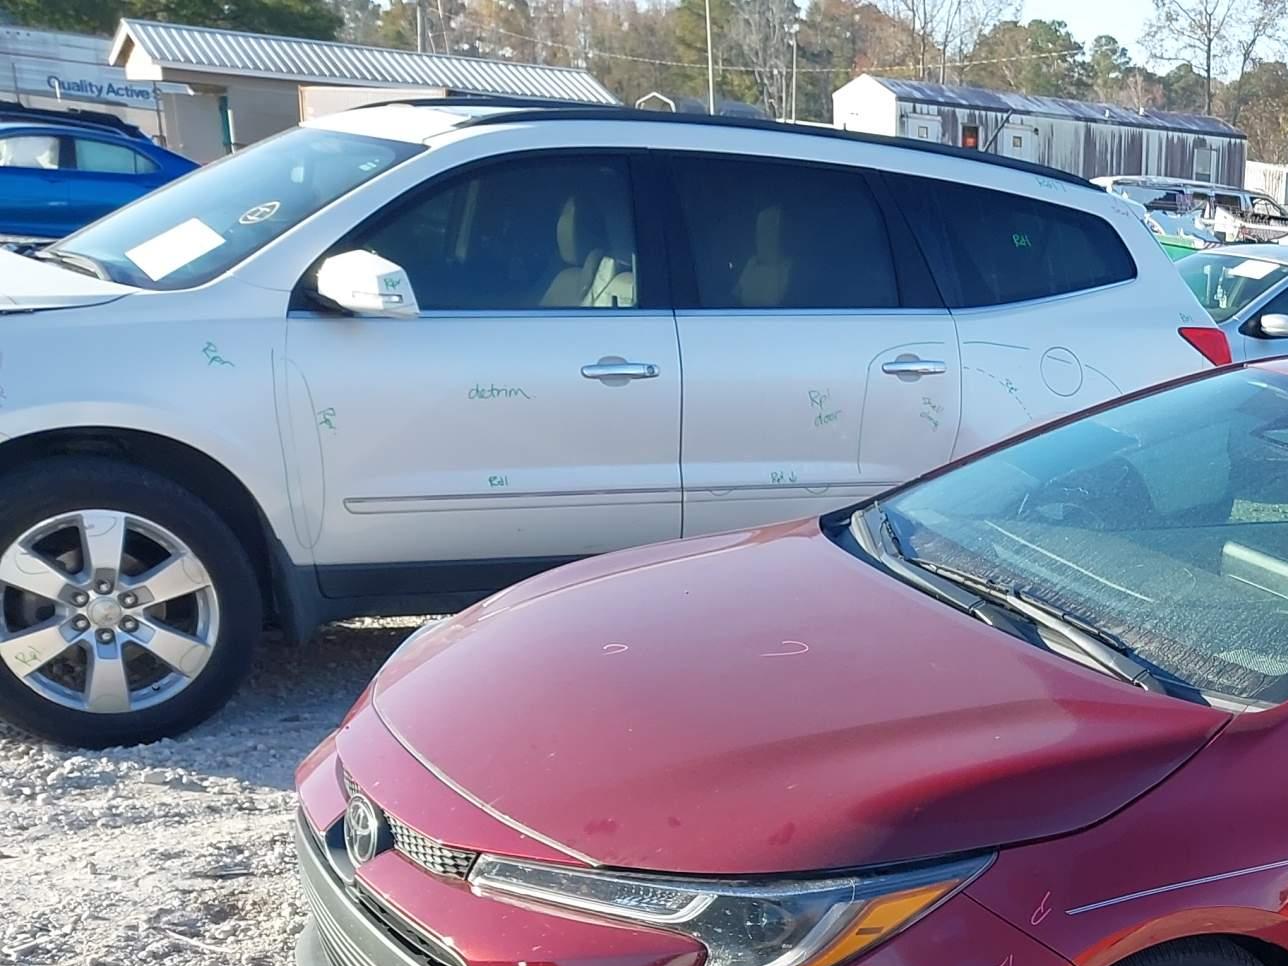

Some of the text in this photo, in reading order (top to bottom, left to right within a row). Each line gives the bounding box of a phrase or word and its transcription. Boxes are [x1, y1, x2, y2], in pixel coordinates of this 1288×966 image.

[47, 75, 104, 98] Quality
[105, 83, 151, 100] Active
[467, 384, 531, 401] detrim
